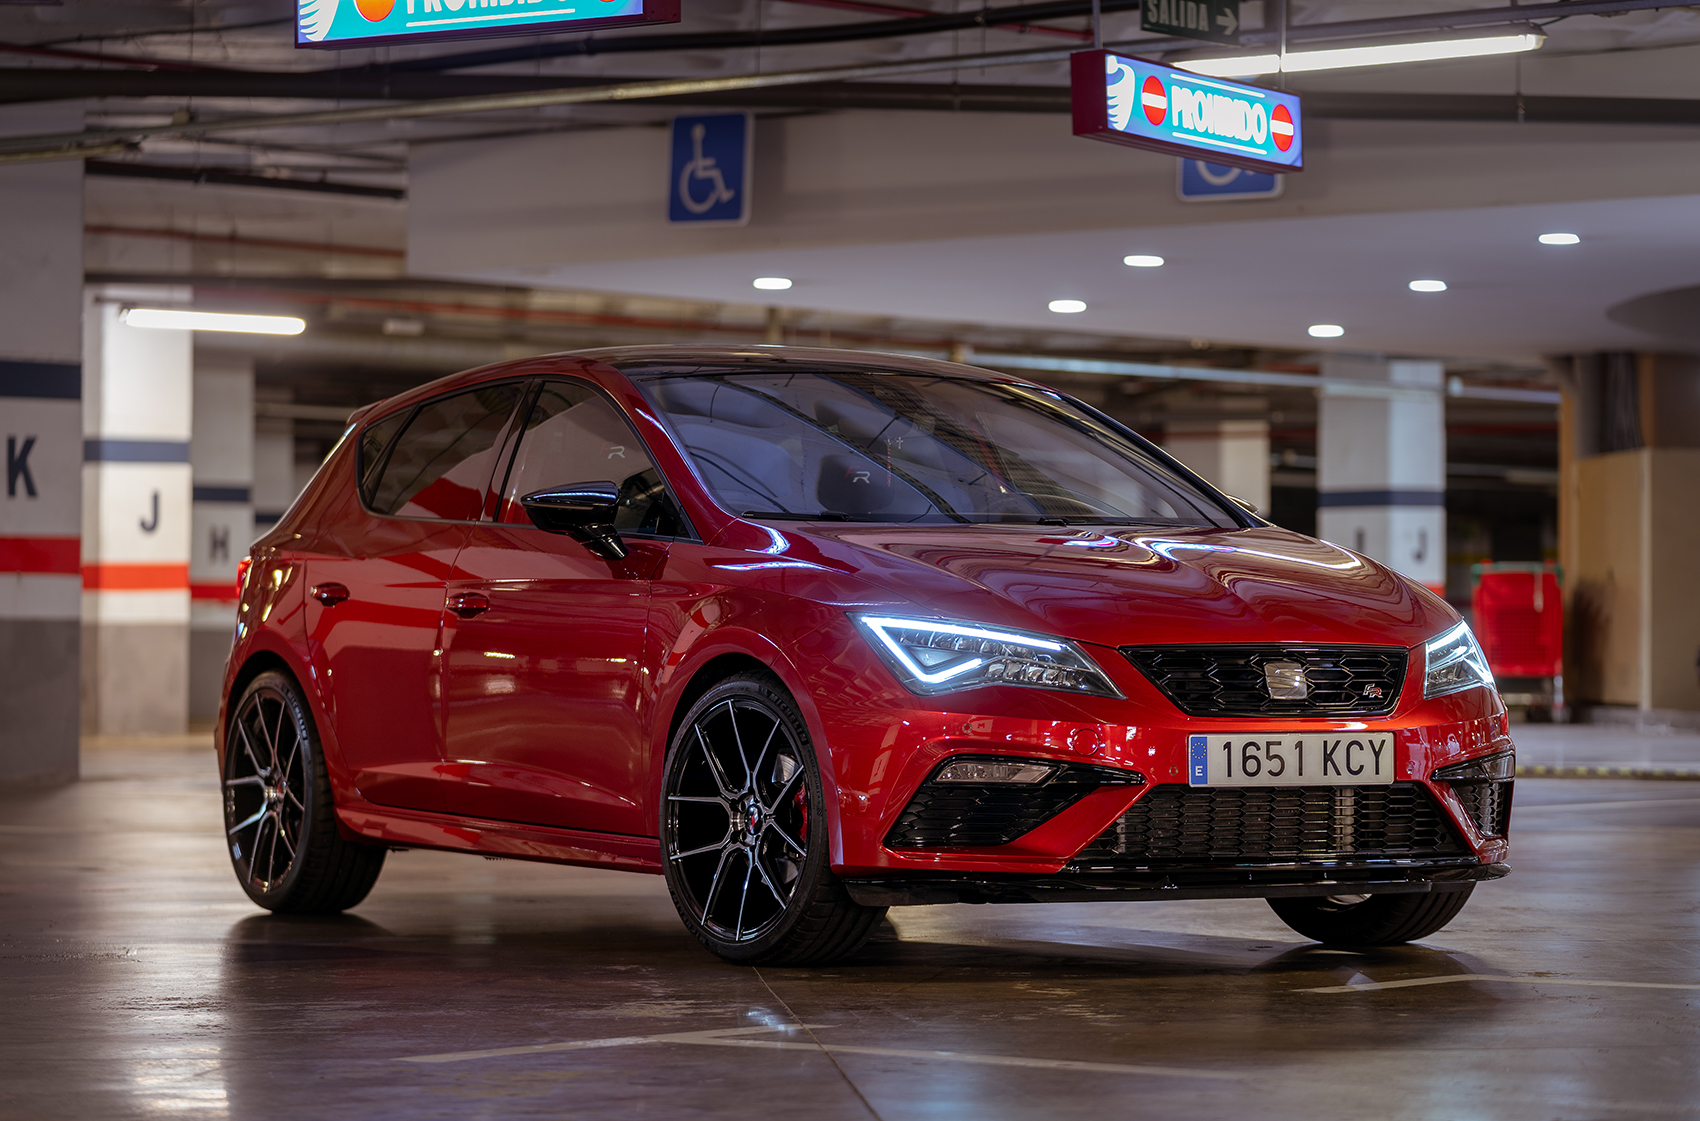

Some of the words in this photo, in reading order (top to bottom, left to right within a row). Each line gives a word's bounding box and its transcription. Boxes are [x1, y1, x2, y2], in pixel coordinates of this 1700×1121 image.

[1147, 0, 1209, 31] SALIDA
[7, 435, 38, 498] K
[140, 490, 159, 533] J
[209, 525, 229, 561] H
[768, 692, 808, 743] MICHELIN
[1195, 765, 1203, 776] E
[1223, 740, 1304, 777] 1651
[1323, 739, 1387, 776] KCY
